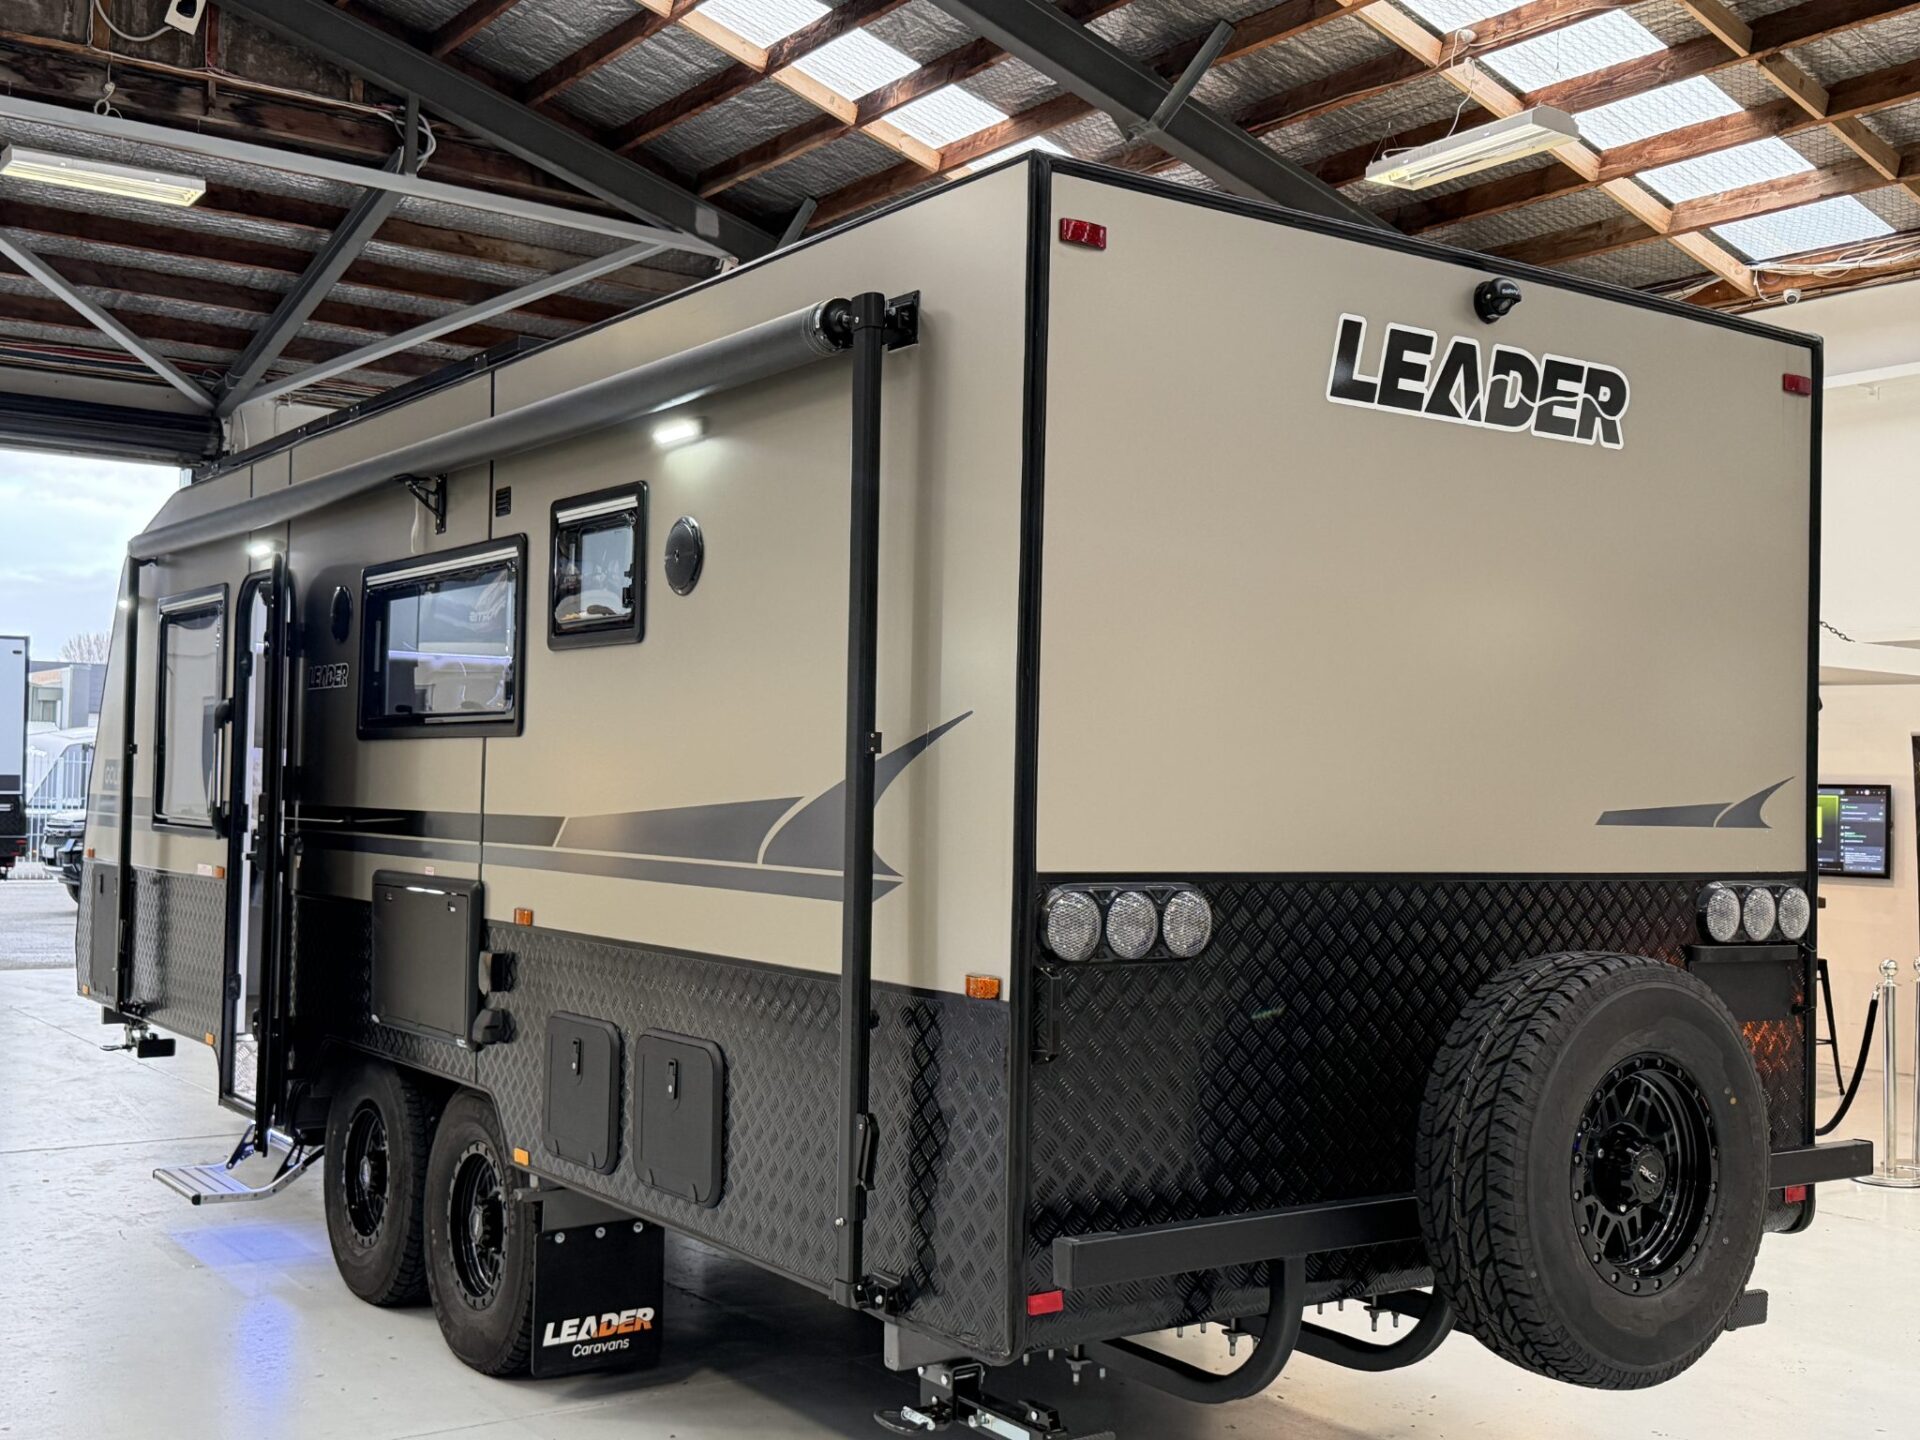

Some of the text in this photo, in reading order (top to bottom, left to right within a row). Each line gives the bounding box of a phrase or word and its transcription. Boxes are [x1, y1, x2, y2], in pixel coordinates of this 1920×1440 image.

[1327, 313, 1628, 450] LEADER
[308, 663, 349, 690] LEADER
[542, 1306, 655, 1347] LEADER
[572, 1338, 630, 1358] Caravans
